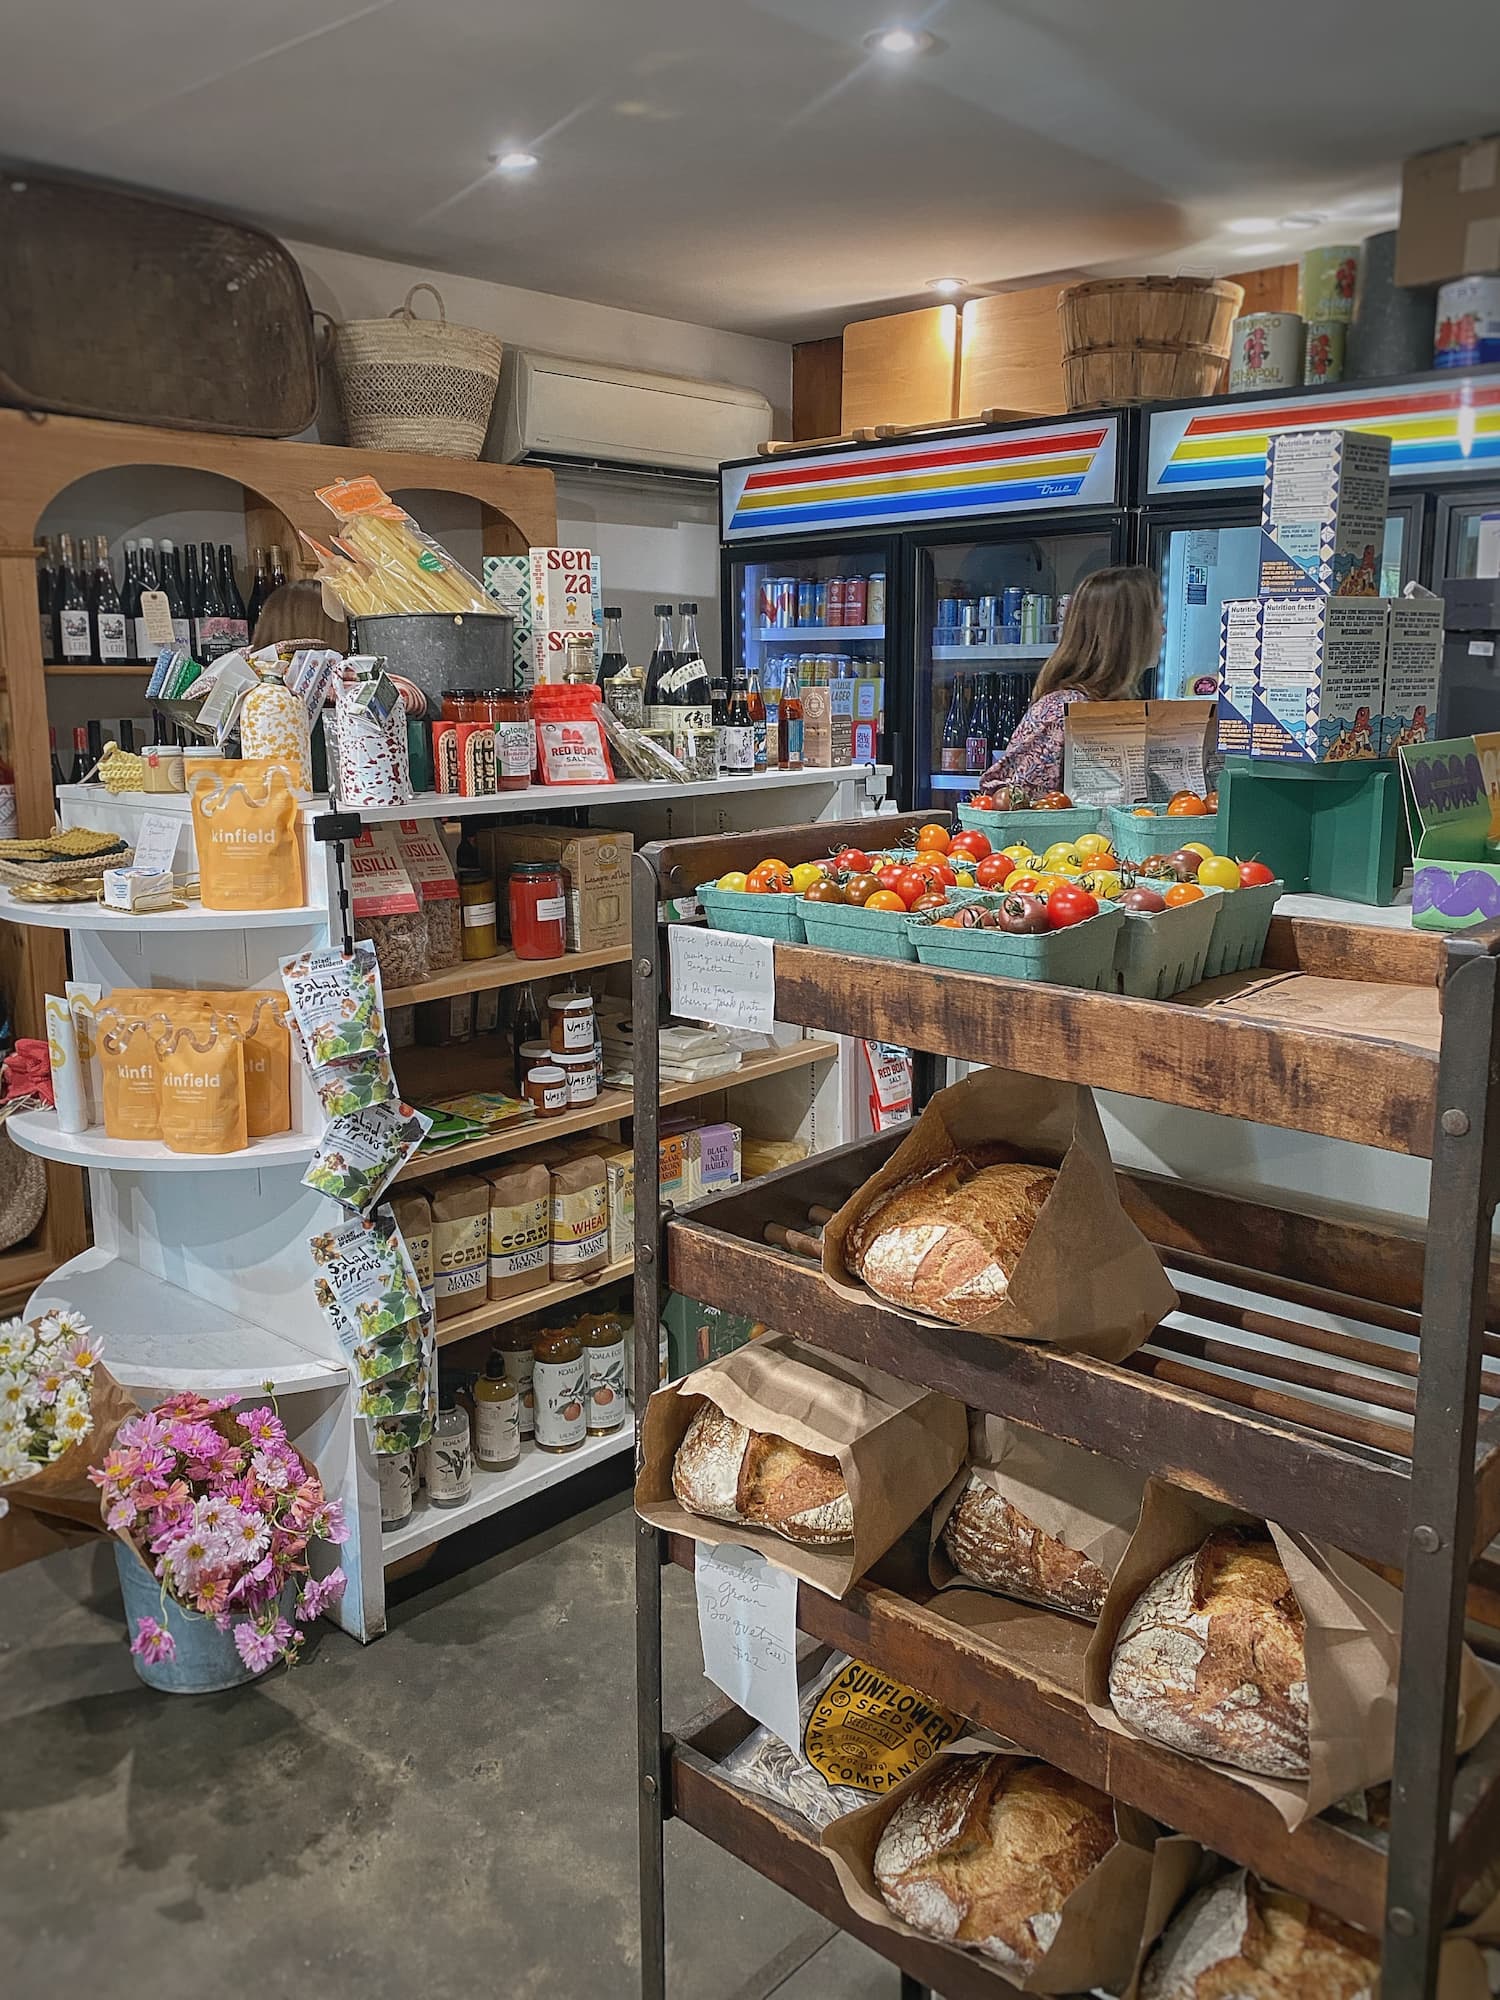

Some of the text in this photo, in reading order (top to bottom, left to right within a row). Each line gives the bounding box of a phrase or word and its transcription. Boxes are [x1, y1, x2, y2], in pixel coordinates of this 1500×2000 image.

[546, 549, 592, 570] sen
[564, 574, 592, 594] za
[551, 746, 598, 756] RED BOAT
[484, 737, 495, 789] DUST
[211, 827, 276, 844] kinfield
[118, 1064, 153, 1080] kinfi
[706, 1145, 728, 1155] BLACK
[571, 1212, 607, 1235] WHEAT
[501, 1223, 548, 1249] CORN
[578, 1237, 605, 1251] MAINE
[440, 1243, 487, 1267] CORN
[509, 1249, 543, 1265] MAINE
[509, 1256, 544, 1272] GRAINS
[447, 1277, 481, 1292] GRAINS
[448, 1270, 481, 1286] MAINE
[839, 1665, 953, 1752] SUNFLOWER
[855, 1698, 915, 1734] SEEDS
[877, 1727, 898, 1745] SALT
[809, 1705, 920, 1789] SNACK COMPANY
